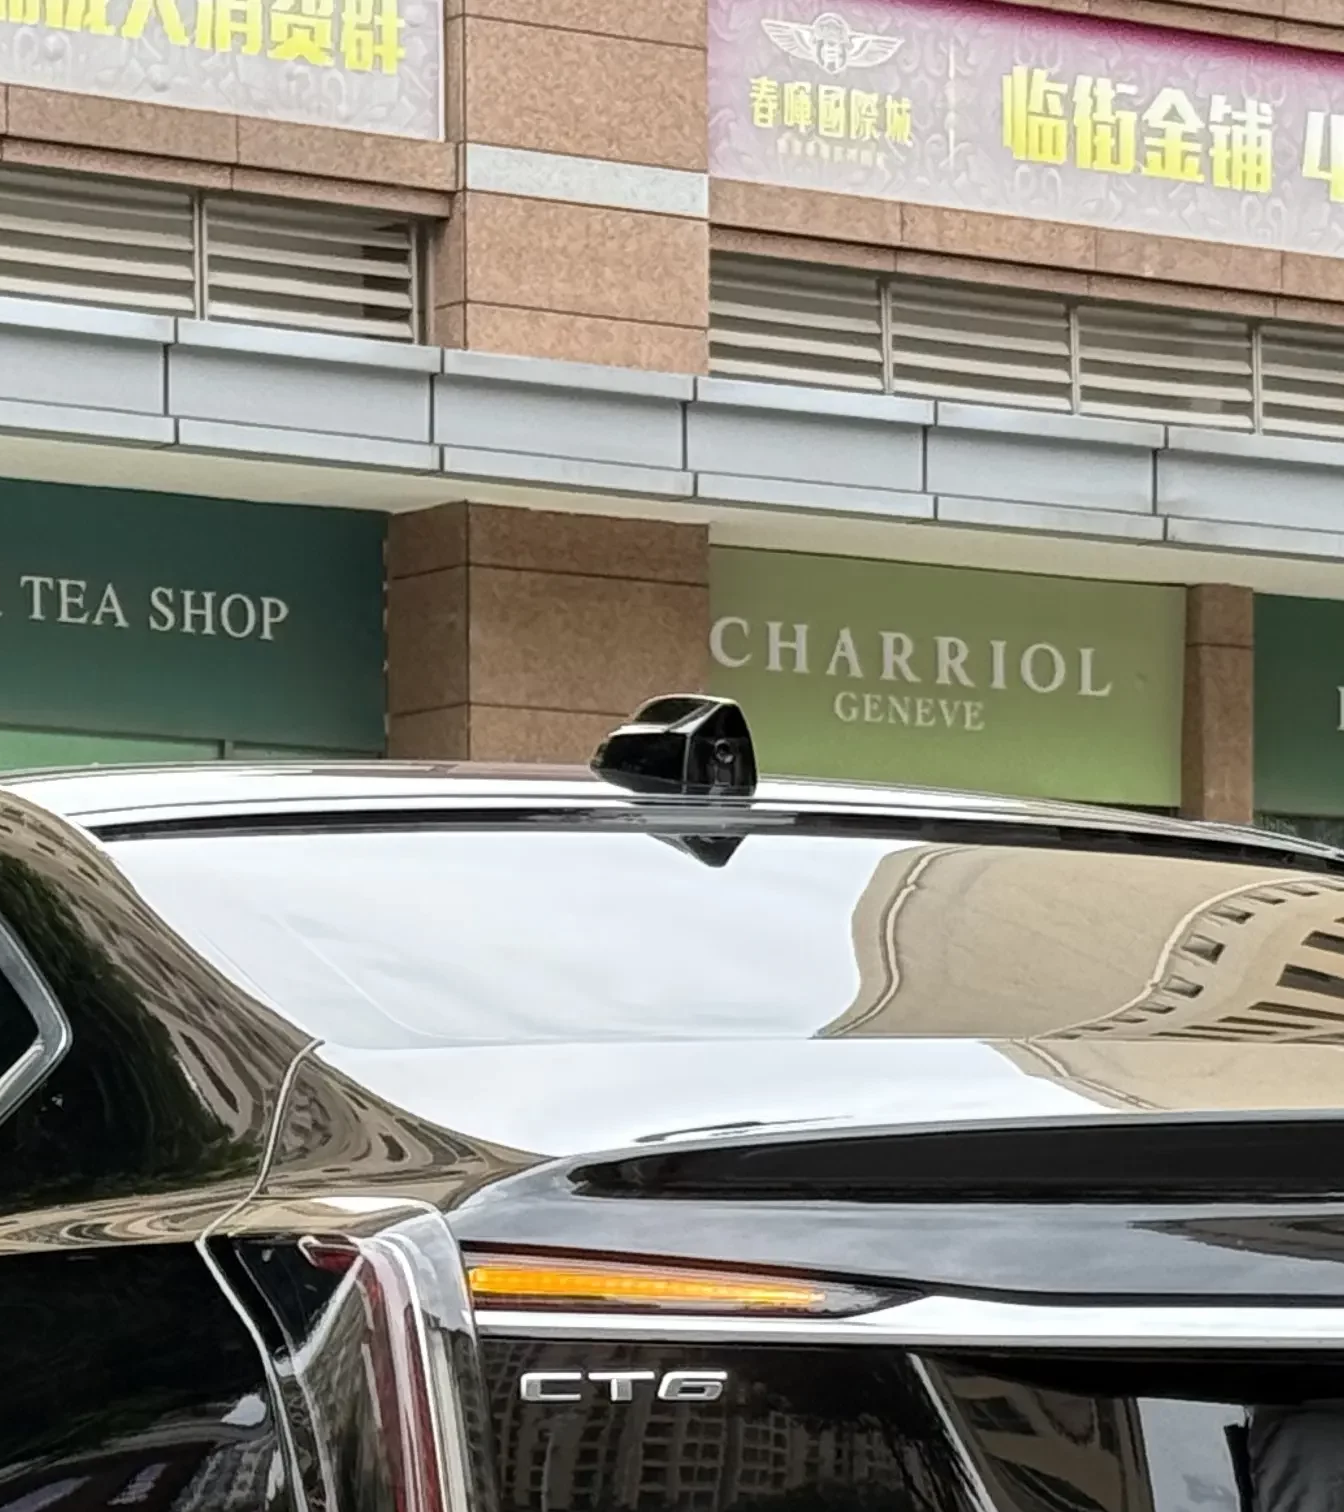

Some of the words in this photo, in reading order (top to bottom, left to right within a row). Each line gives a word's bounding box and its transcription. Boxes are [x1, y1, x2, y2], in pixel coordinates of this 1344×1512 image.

[1002, 65, 1273, 193] 临街金铺
[20, 575, 130, 628] TEA
[149, 587, 290, 641] SHOP
[709, 616, 1112, 697] CHARRIOL
[834, 691, 985, 731] GENEVE
[520, 1371, 728, 1401] CT6
